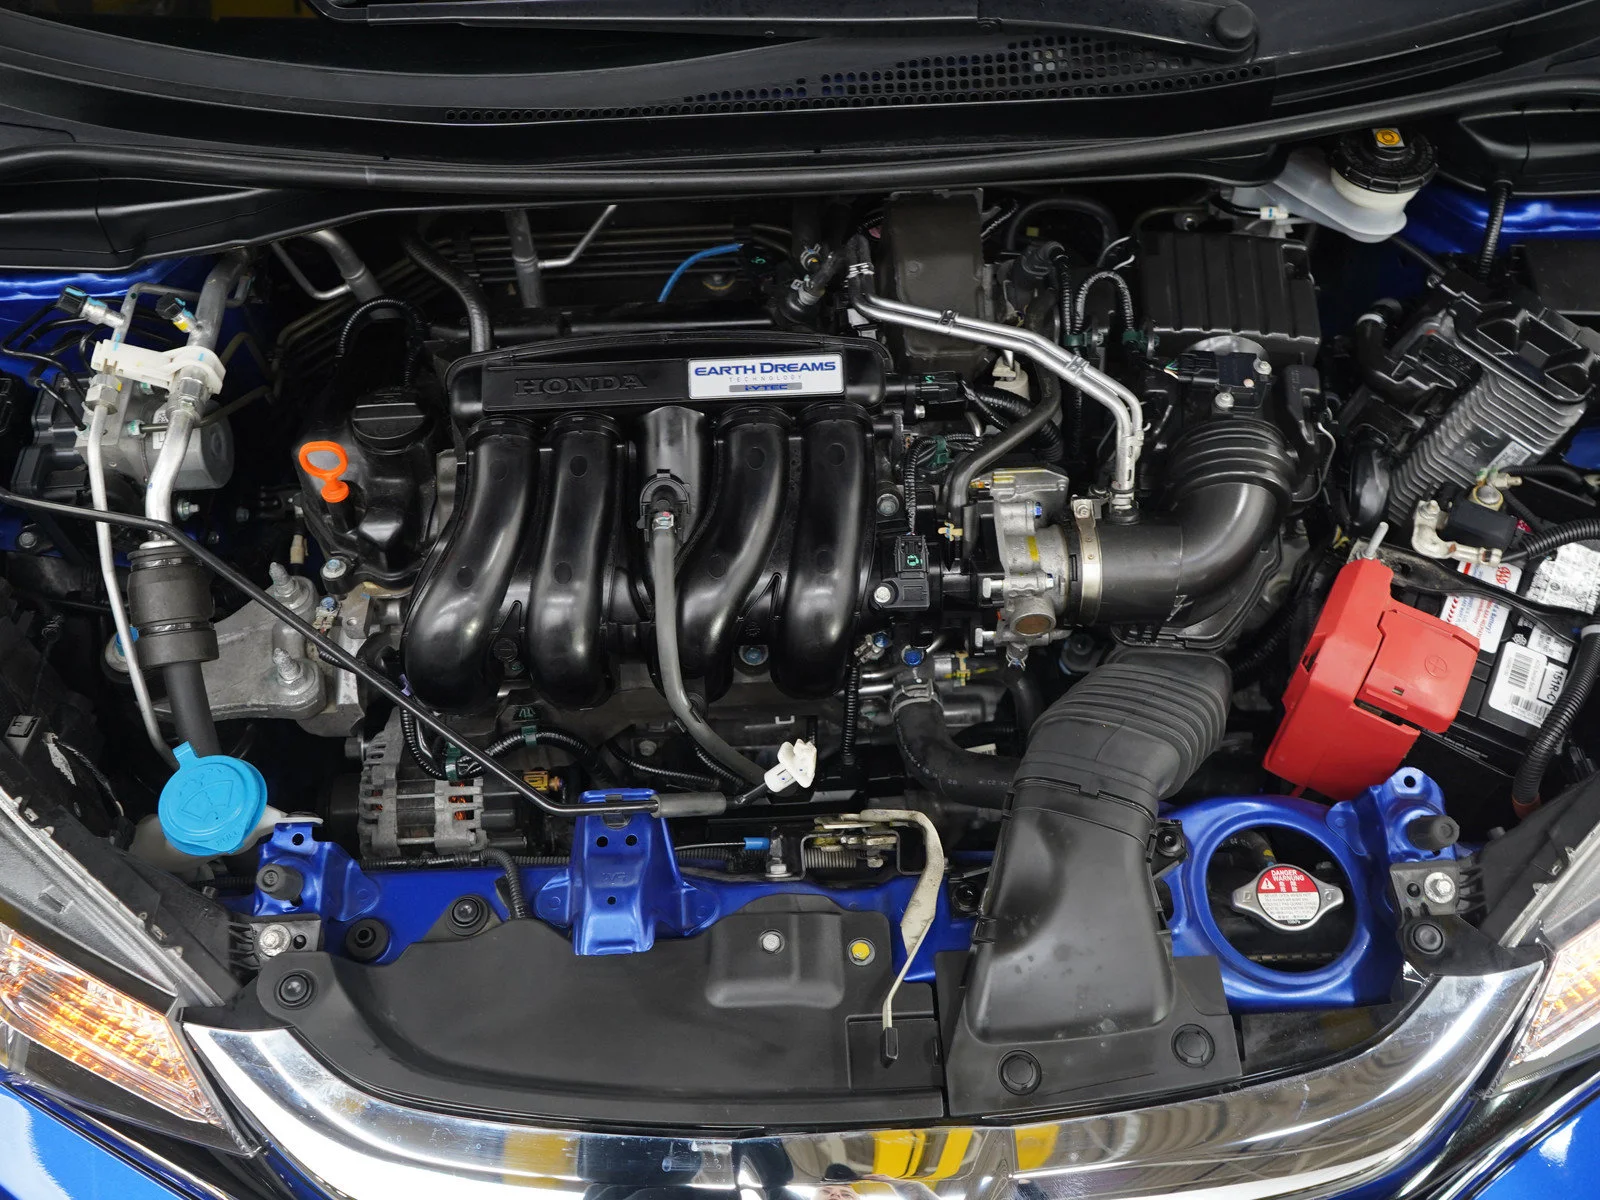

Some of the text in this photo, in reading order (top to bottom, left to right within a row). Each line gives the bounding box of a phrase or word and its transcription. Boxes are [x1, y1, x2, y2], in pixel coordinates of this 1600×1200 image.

[694, 361, 836, 377] EARTH DREAMS
[513, 374, 648, 395] HONDA
[729, 375, 803, 383] TECHNOLOGY
[1546, 670, 1564, 701] 151R-C
